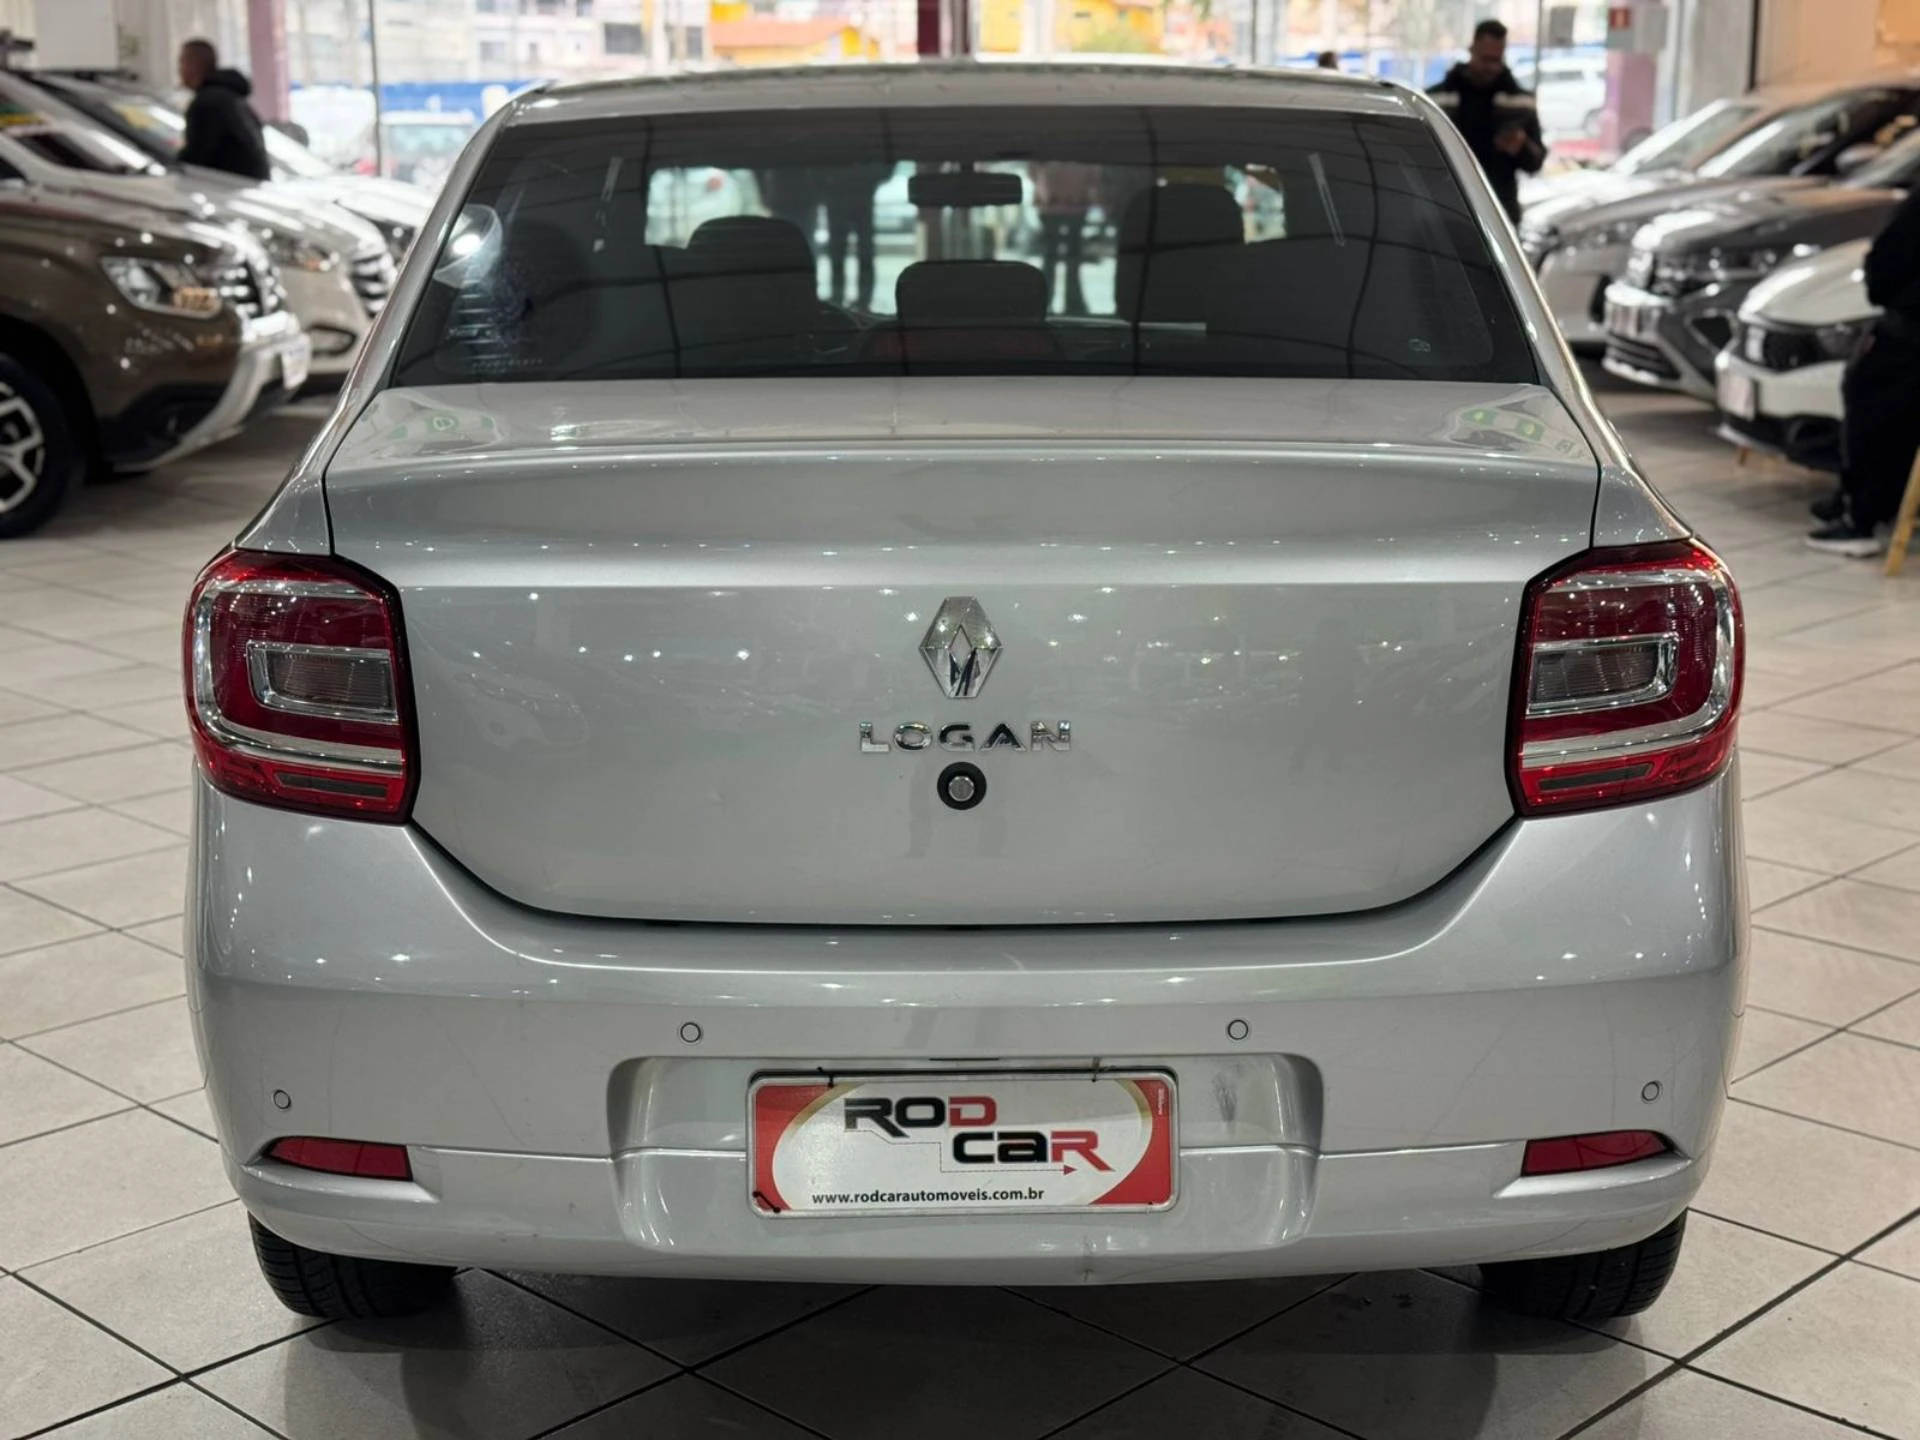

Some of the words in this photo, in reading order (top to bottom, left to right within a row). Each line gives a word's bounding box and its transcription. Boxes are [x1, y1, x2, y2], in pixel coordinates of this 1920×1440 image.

[859, 721, 1071, 753] LOGAN
[845, 1095, 997, 1138] ROD
[812, 1187, 1045, 1204] www.rodcarautomoveis.com.br
